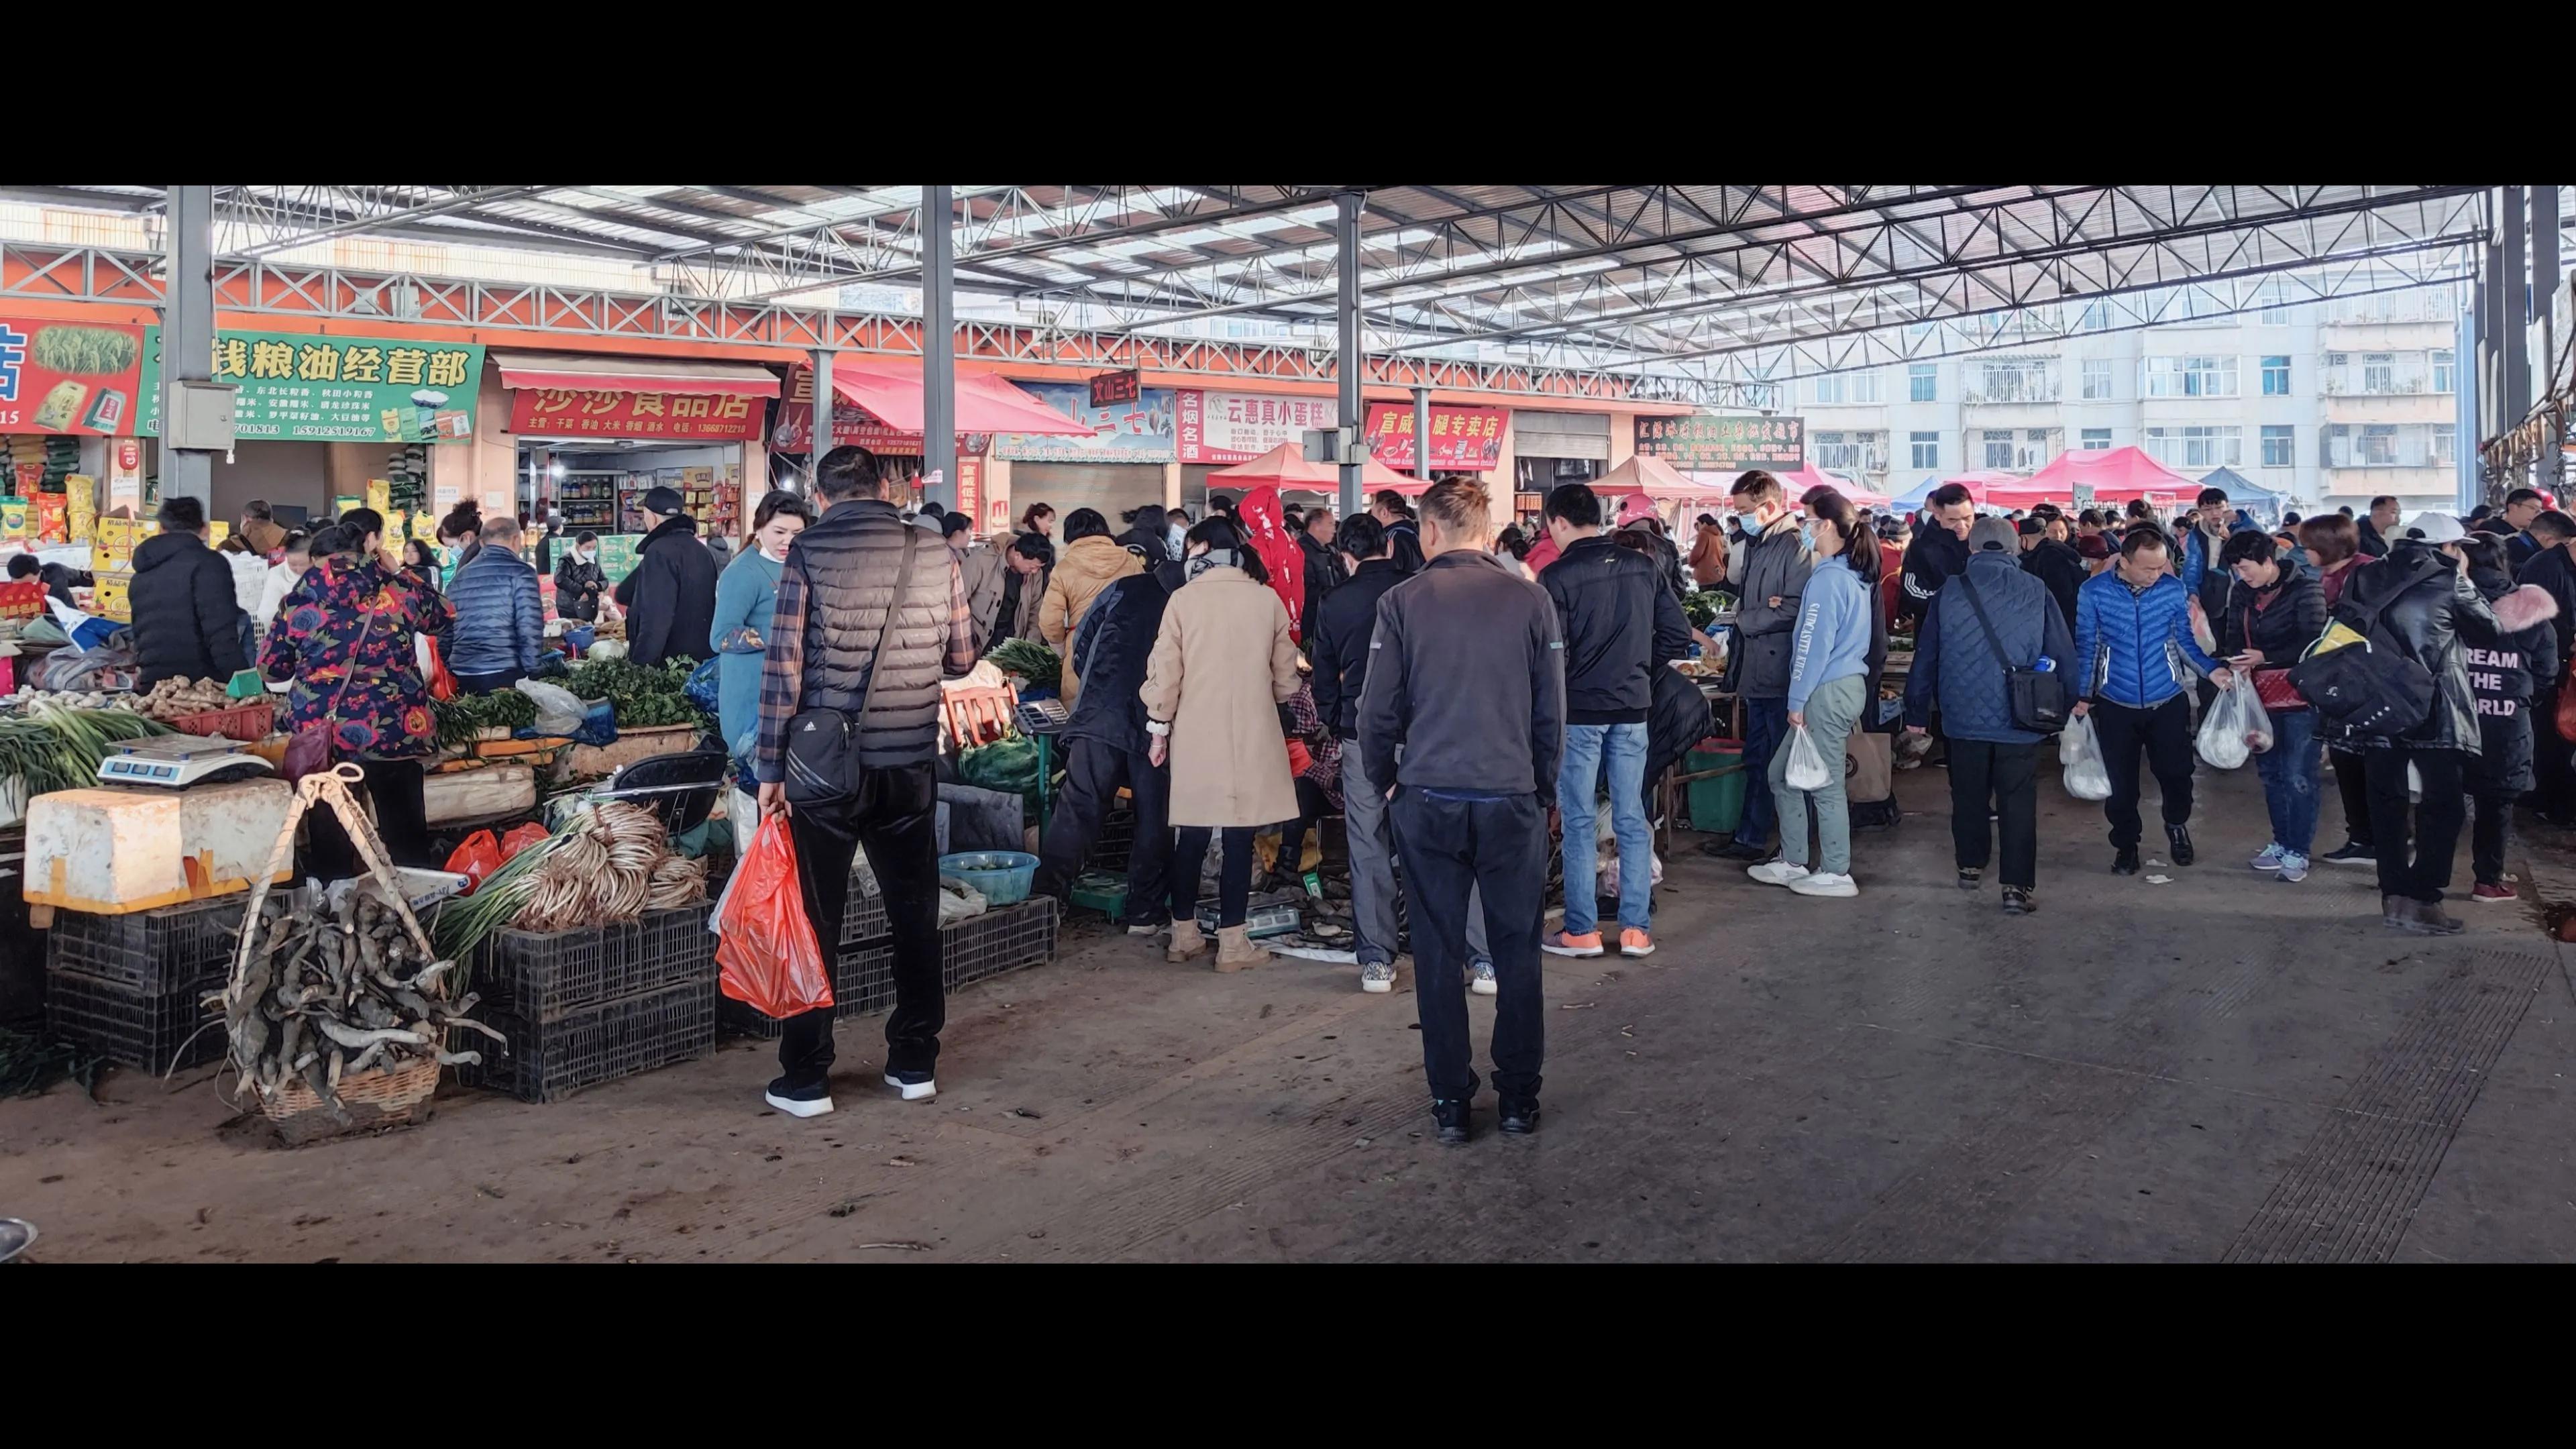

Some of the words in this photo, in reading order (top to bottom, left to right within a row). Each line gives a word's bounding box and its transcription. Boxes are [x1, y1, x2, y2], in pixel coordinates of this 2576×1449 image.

[153, 336, 471, 386] 钱粮油经营部
[1094, 376, 1136, 402] 文山三七
[581, 419, 598, 430] 香油
[603, 419, 621, 431] 大米
[625, 420, 643, 431] 香烟
[647, 421, 663, 432] 酒水
[1182, 392, 1199, 459] 名烟名酒
[1228, 398, 1324, 427] 云惠真小蛋糕
[1379, 411, 1499, 437] 宣威腿专卖店
[2466, 648, 2518, 668] REAM
[2477, 698, 2516, 716] RLD
